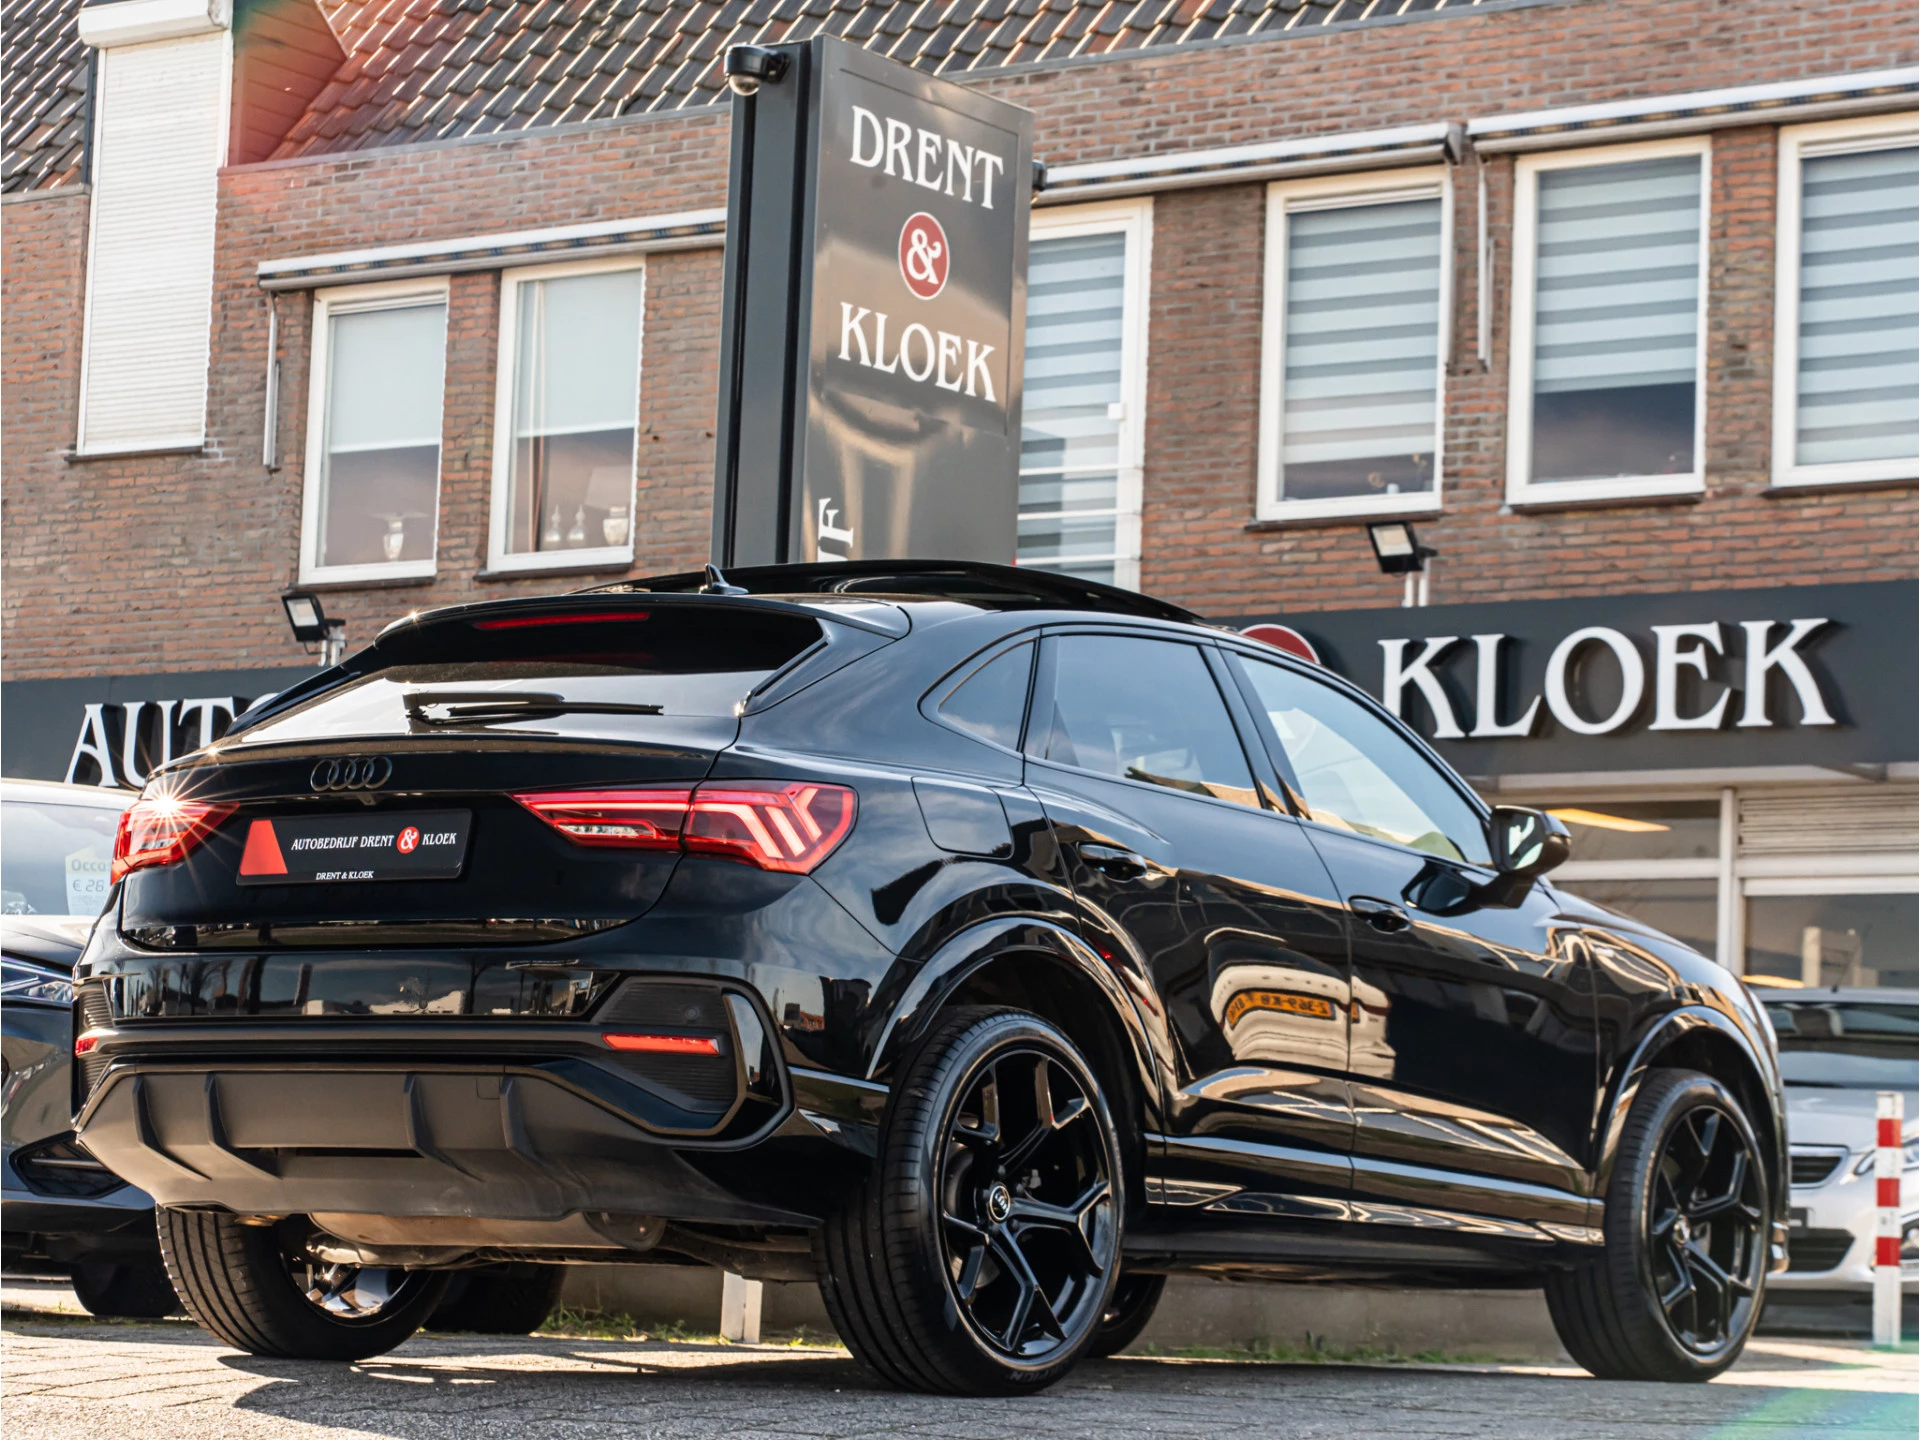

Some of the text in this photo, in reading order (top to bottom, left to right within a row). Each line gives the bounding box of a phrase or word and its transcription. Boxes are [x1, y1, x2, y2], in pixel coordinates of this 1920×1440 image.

[850, 105, 1004, 209] DRENT
[906, 228, 942, 285] &
[838, 302, 997, 402] KLOEK
[1377, 617, 1836, 739] KLOEK
[63, 693, 280, 788] AUT
[71, 858, 112, 872] Occa
[291, 829, 457, 850] AUTOBEDRIJF DRENT & KLOEK
[316, 870, 374, 880] DRENT & KLOEK
